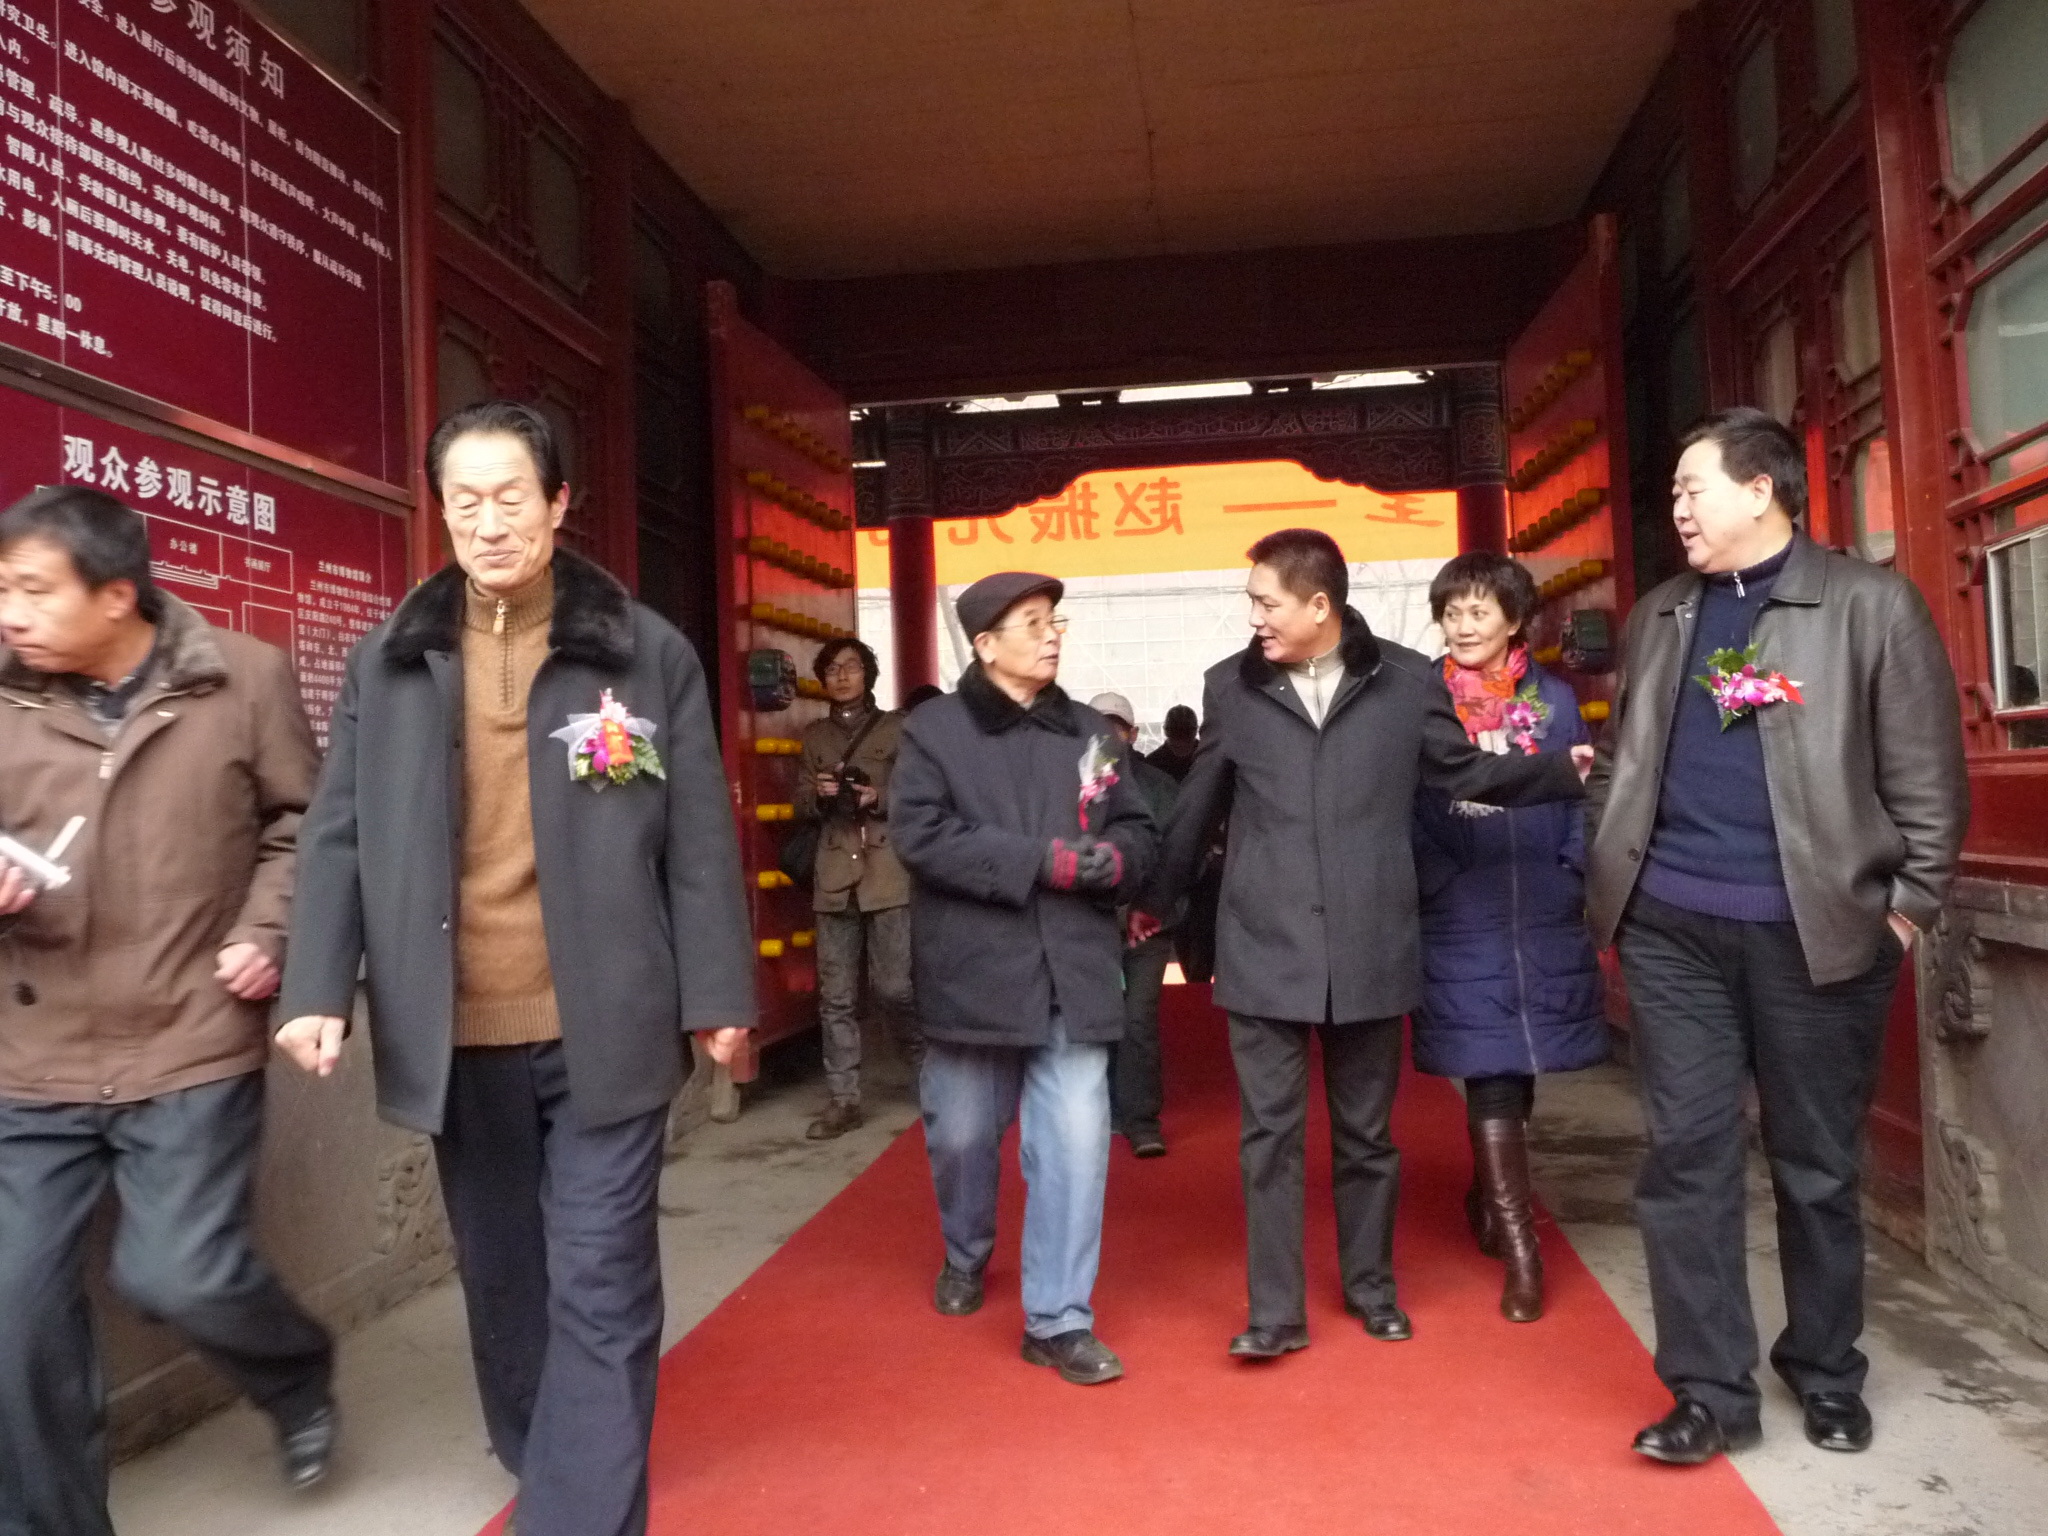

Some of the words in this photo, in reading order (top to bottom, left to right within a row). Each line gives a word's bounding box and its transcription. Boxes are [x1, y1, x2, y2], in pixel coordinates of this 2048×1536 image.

[63, 435, 275, 534] 观众参观示意图
